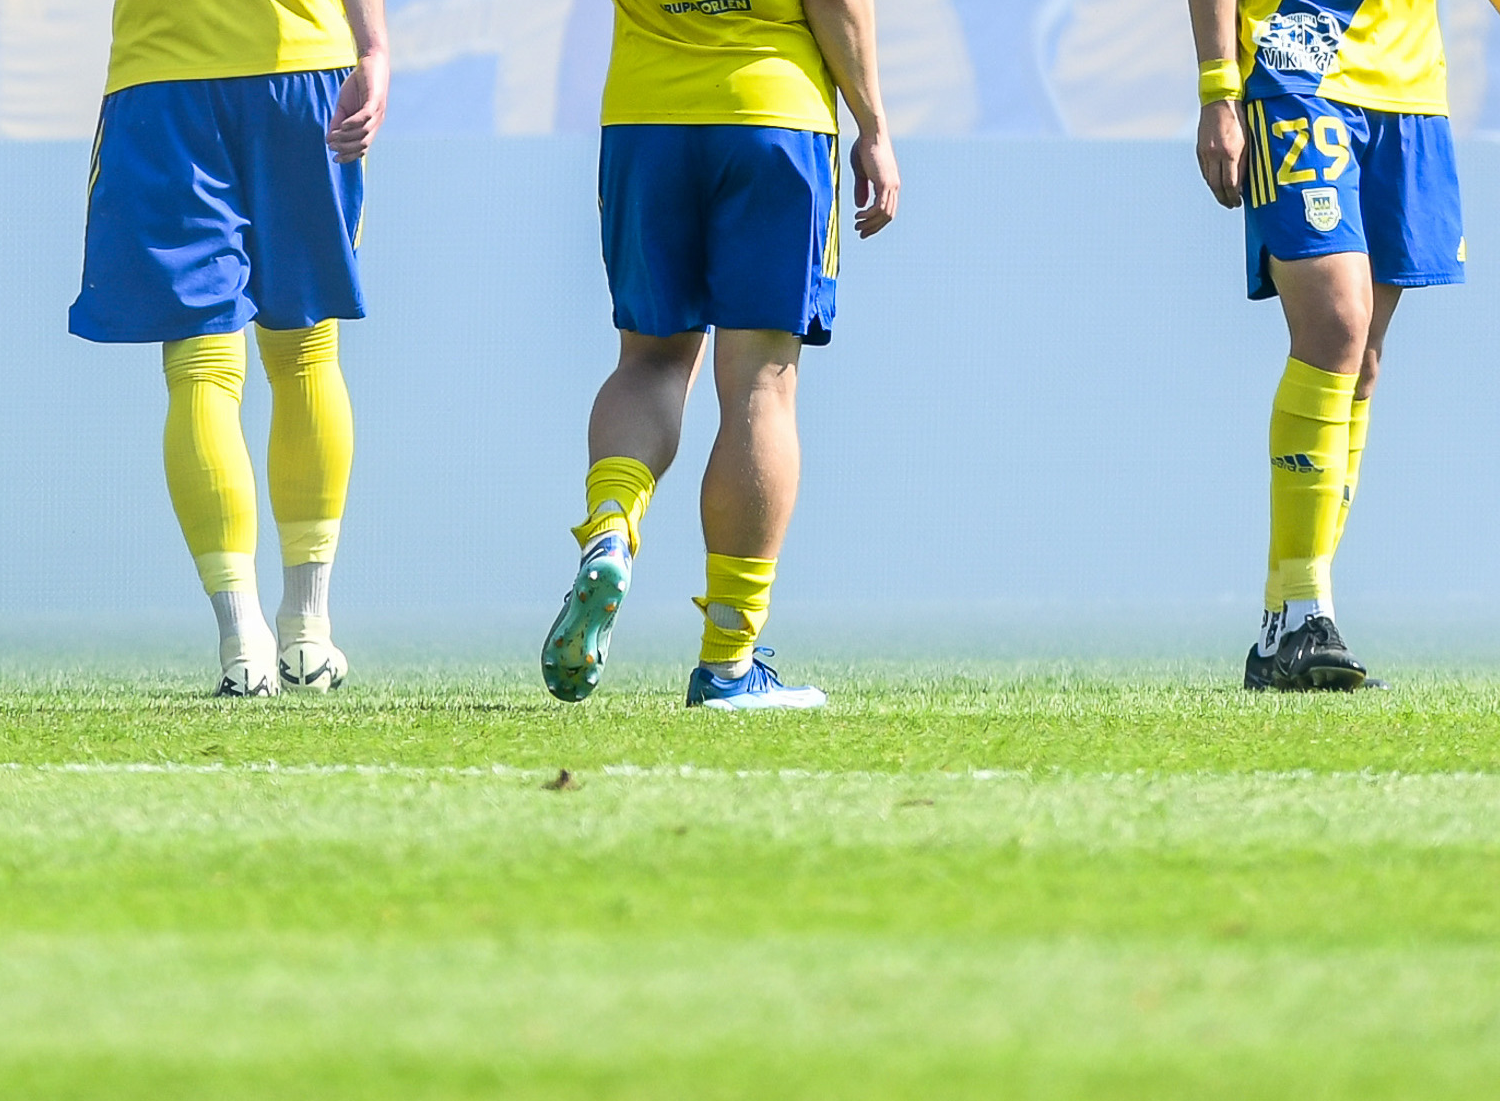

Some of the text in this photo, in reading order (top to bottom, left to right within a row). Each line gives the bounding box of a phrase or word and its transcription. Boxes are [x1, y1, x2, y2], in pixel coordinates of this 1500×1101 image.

[660, 0, 748, 15] RUPA ORLEN
[1272, 115, 1350, 185] 29
